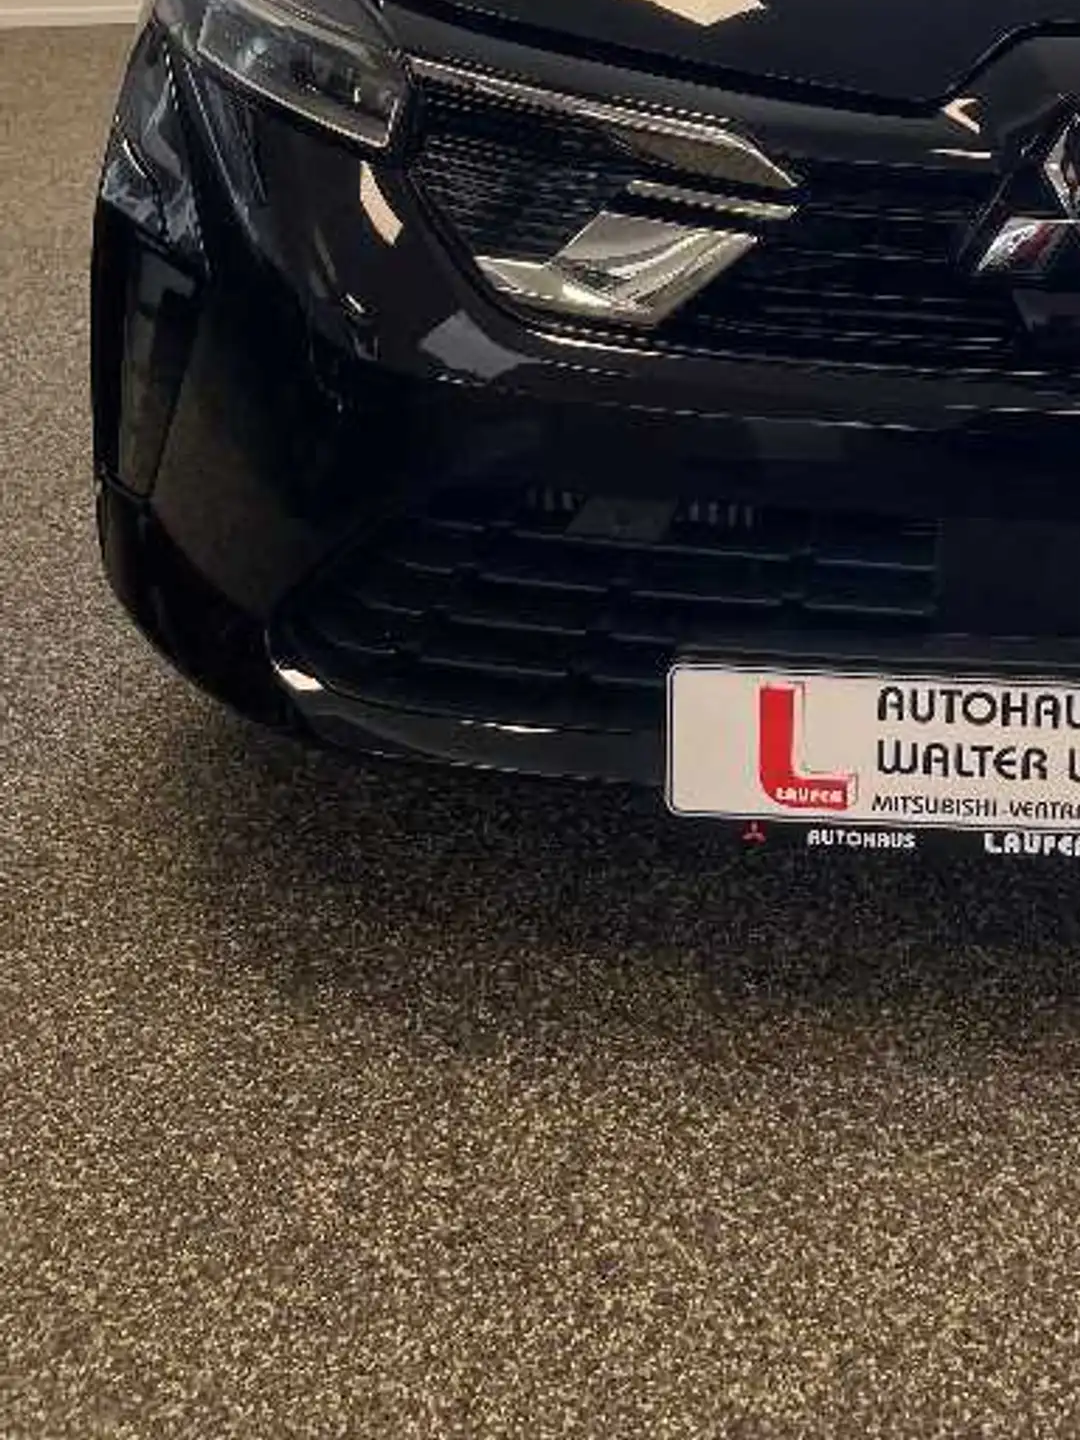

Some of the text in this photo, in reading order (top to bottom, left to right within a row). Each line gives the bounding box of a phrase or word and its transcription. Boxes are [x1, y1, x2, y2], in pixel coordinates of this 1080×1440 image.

[877, 739, 1048, 780] WALTER
[775, 787, 845, 805] LAUFER
[807, 829, 916, 849] AUTOHAUS
